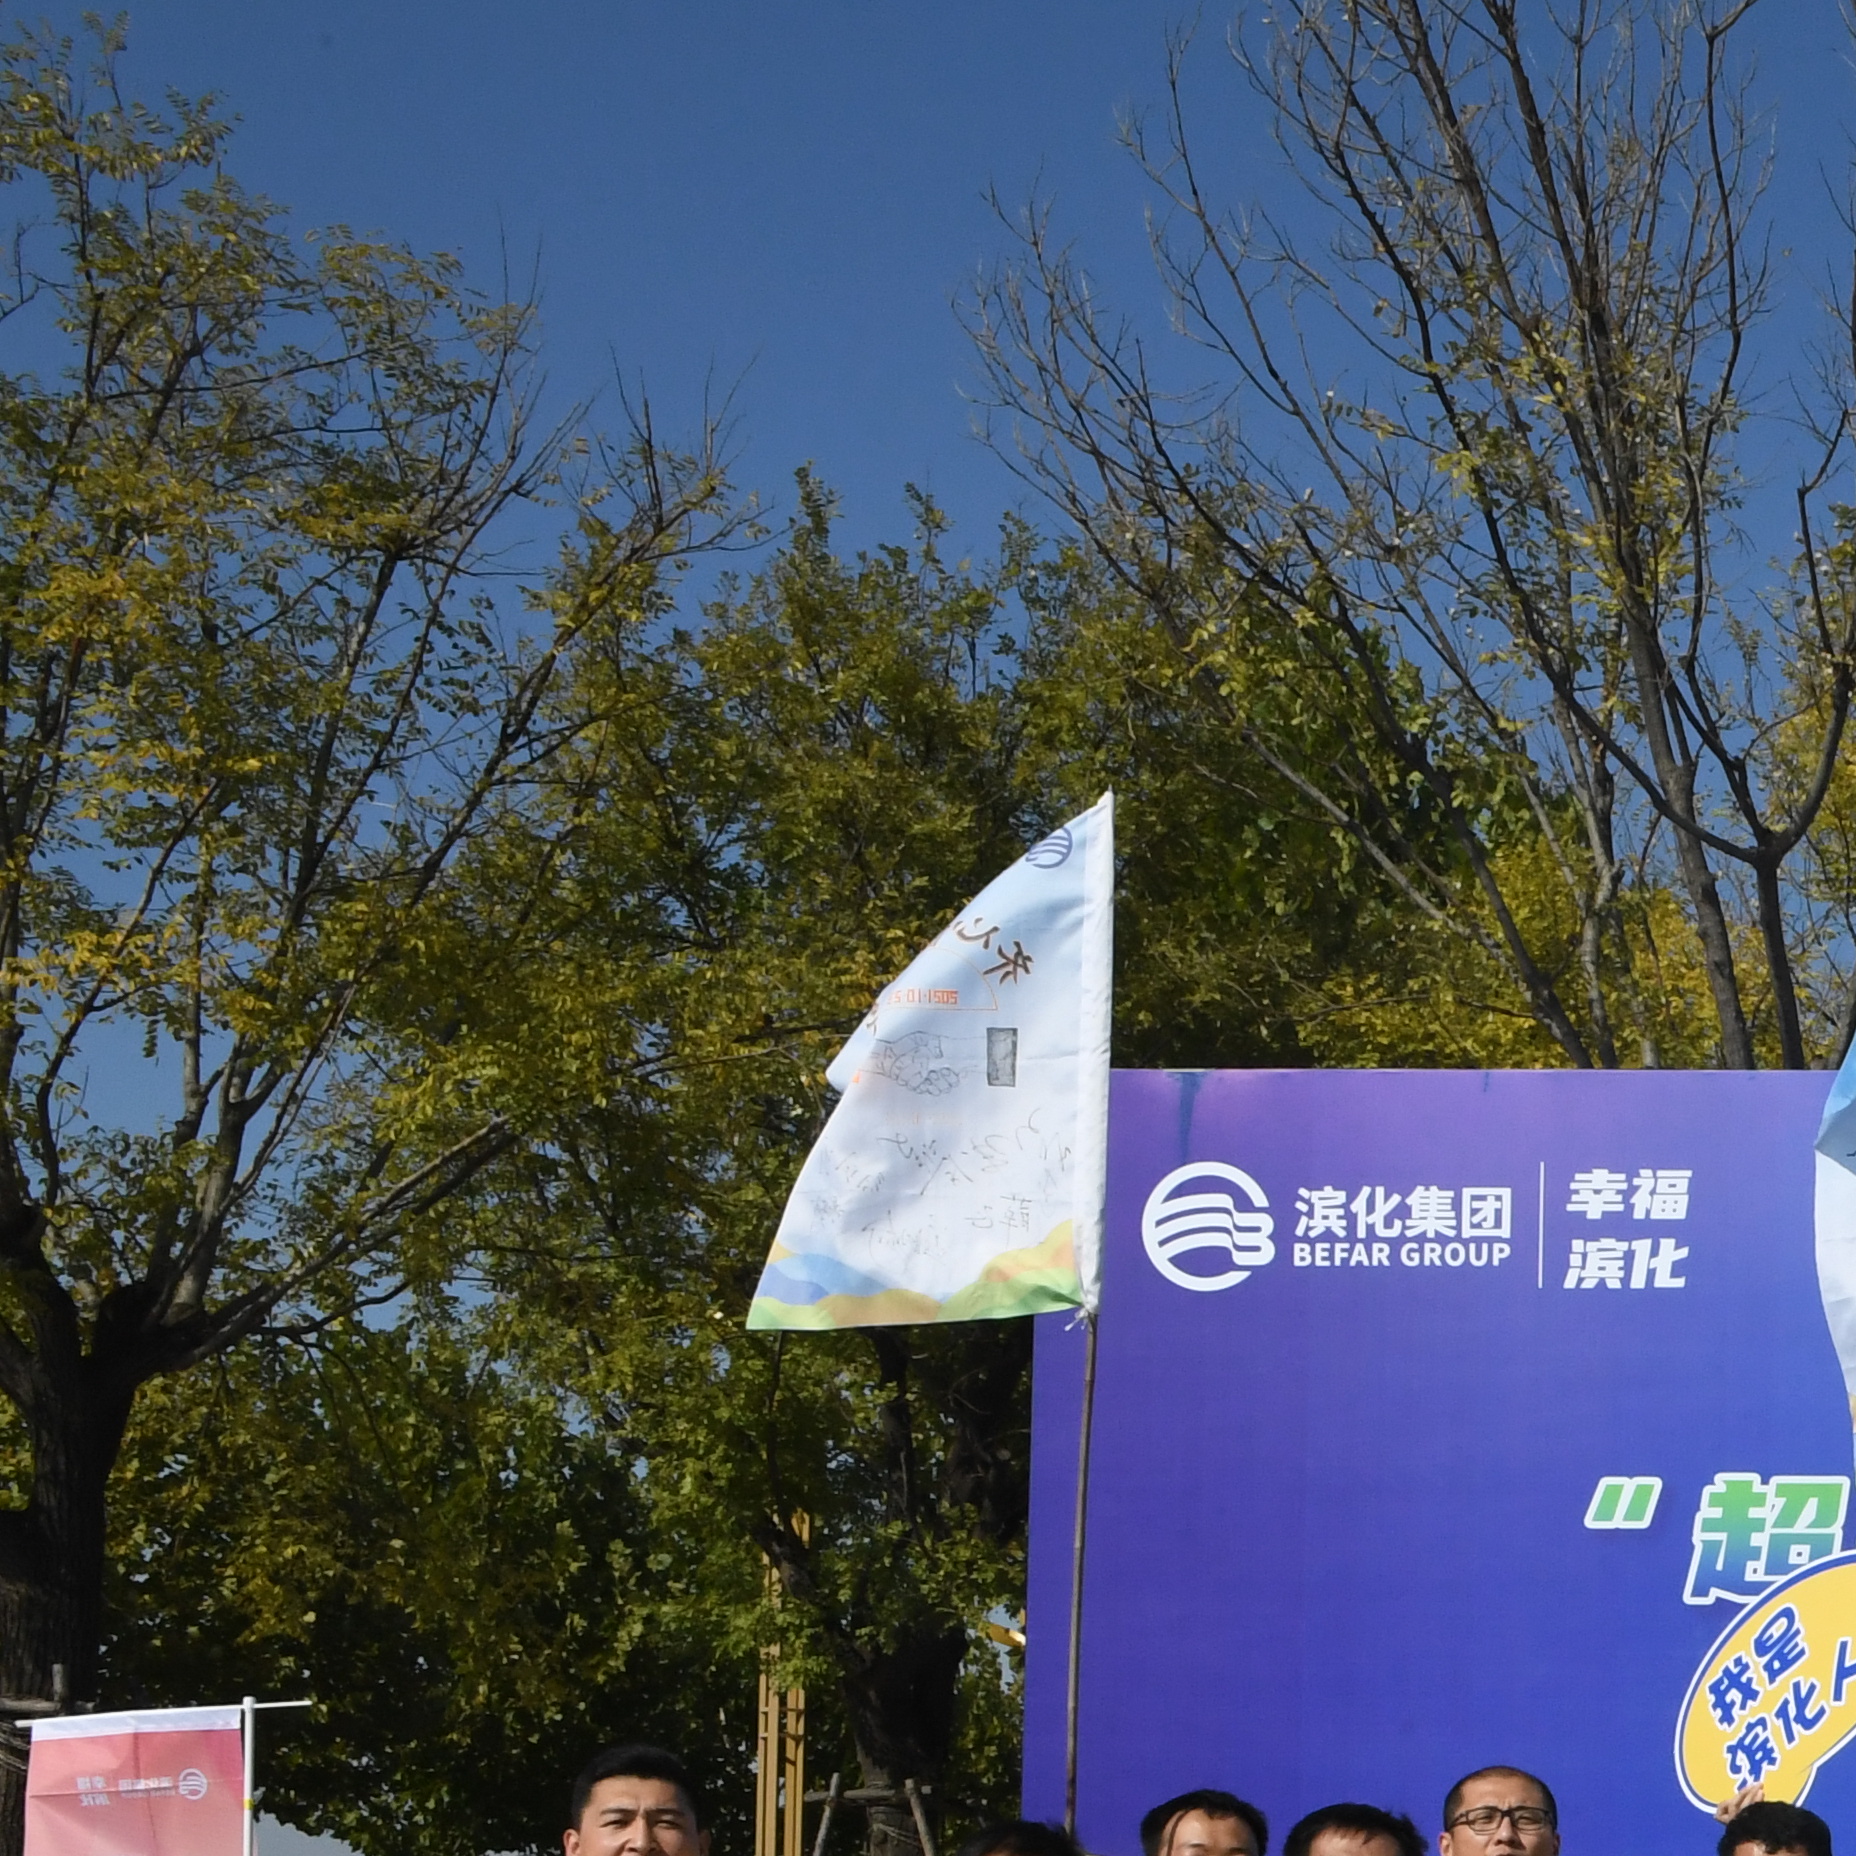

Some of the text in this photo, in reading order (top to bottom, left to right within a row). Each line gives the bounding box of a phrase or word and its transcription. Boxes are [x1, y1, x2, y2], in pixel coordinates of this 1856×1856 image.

[1294, 1186, 1512, 1239] 滨化集团
[1565, 1168, 1693, 1221] 幸福
[1293, 1242, 1512, 1267] BEFAR GROUP
[1562, 1237, 1690, 1290] 滨化
[1707, 1605, 1808, 1729] 我是
